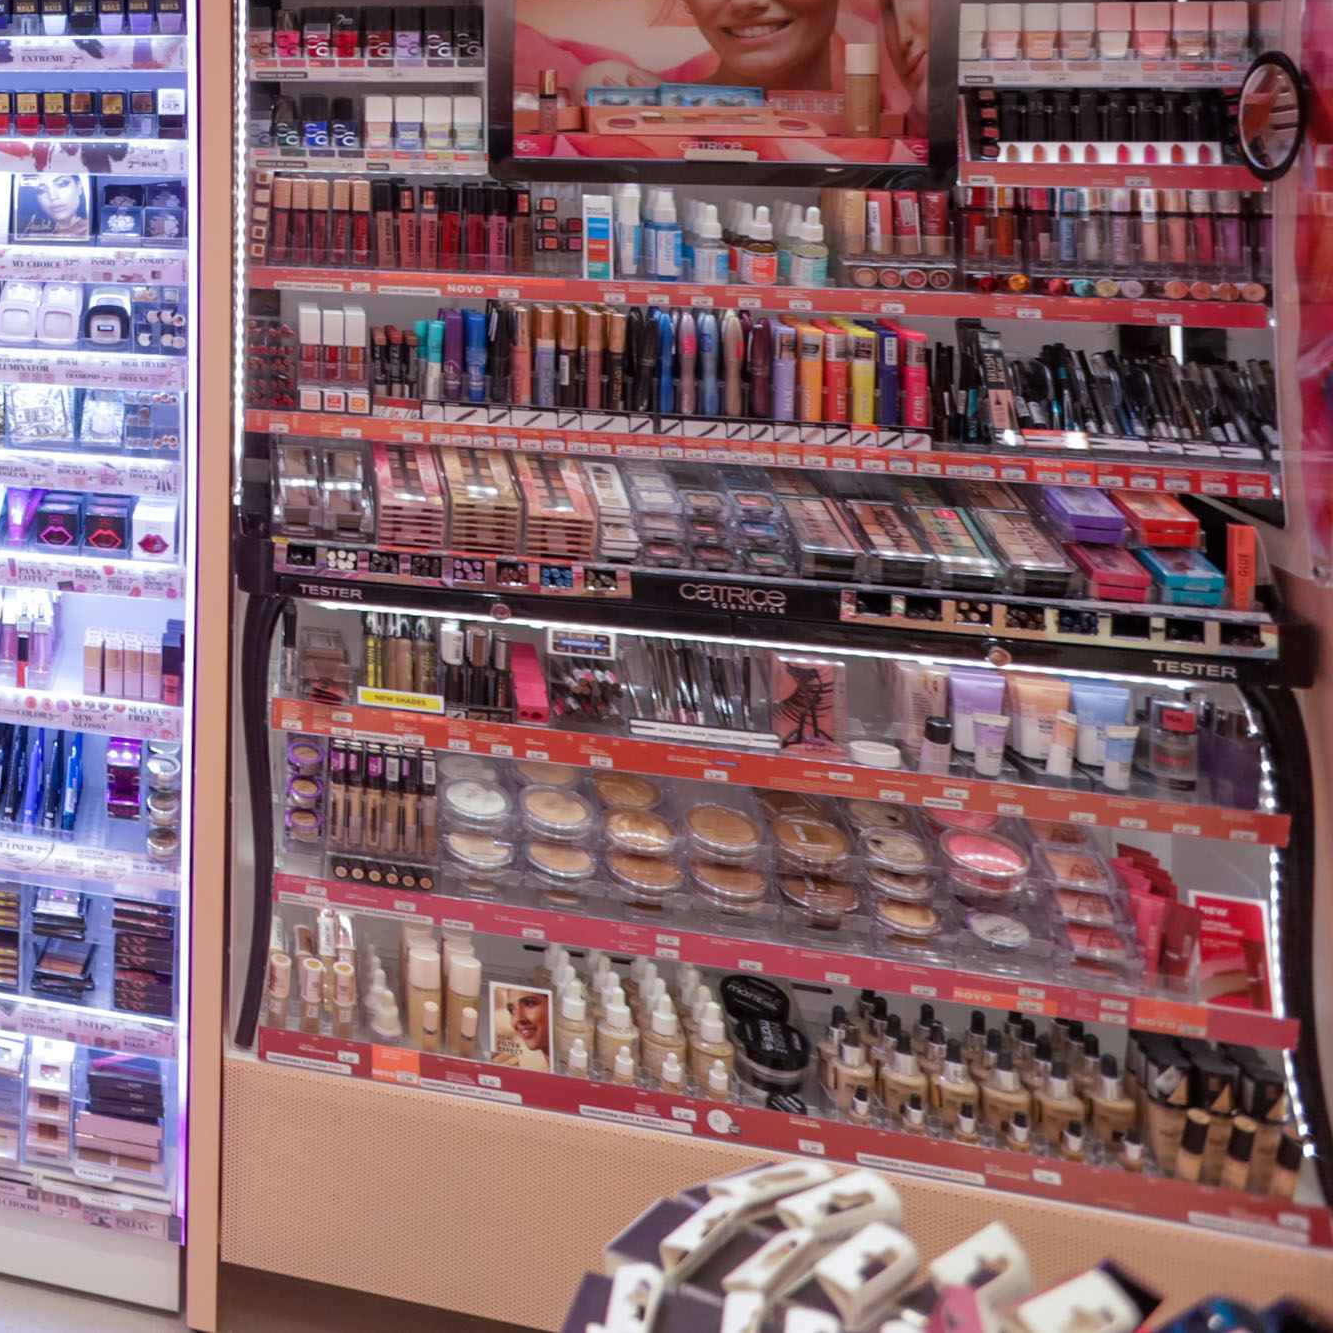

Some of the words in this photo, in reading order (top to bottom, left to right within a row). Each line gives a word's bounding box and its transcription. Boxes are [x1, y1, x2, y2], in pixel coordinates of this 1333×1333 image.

[20, 55, 65, 63] EXTREME
[12, 260, 27, 268] MY
[29, 261, 62, 269] CHOICE
[447, 284, 484, 295] NOVO
[298, 583, 363, 600] TESTER
[712, 601, 785, 615] COSMETICS
[1153, 659, 1238, 678] TESTER
[375, 692, 393, 702] NEW
[397, 695, 427, 707] SHADES
[1199, 904, 1229, 918] NEW
[953, 988, 992, 1002] NOVO
[1136, 1016, 1175, 1030] NOVO
[497, 1039, 521, 1050] FILTER
[497, 1046, 523, 1057] EFFECT
